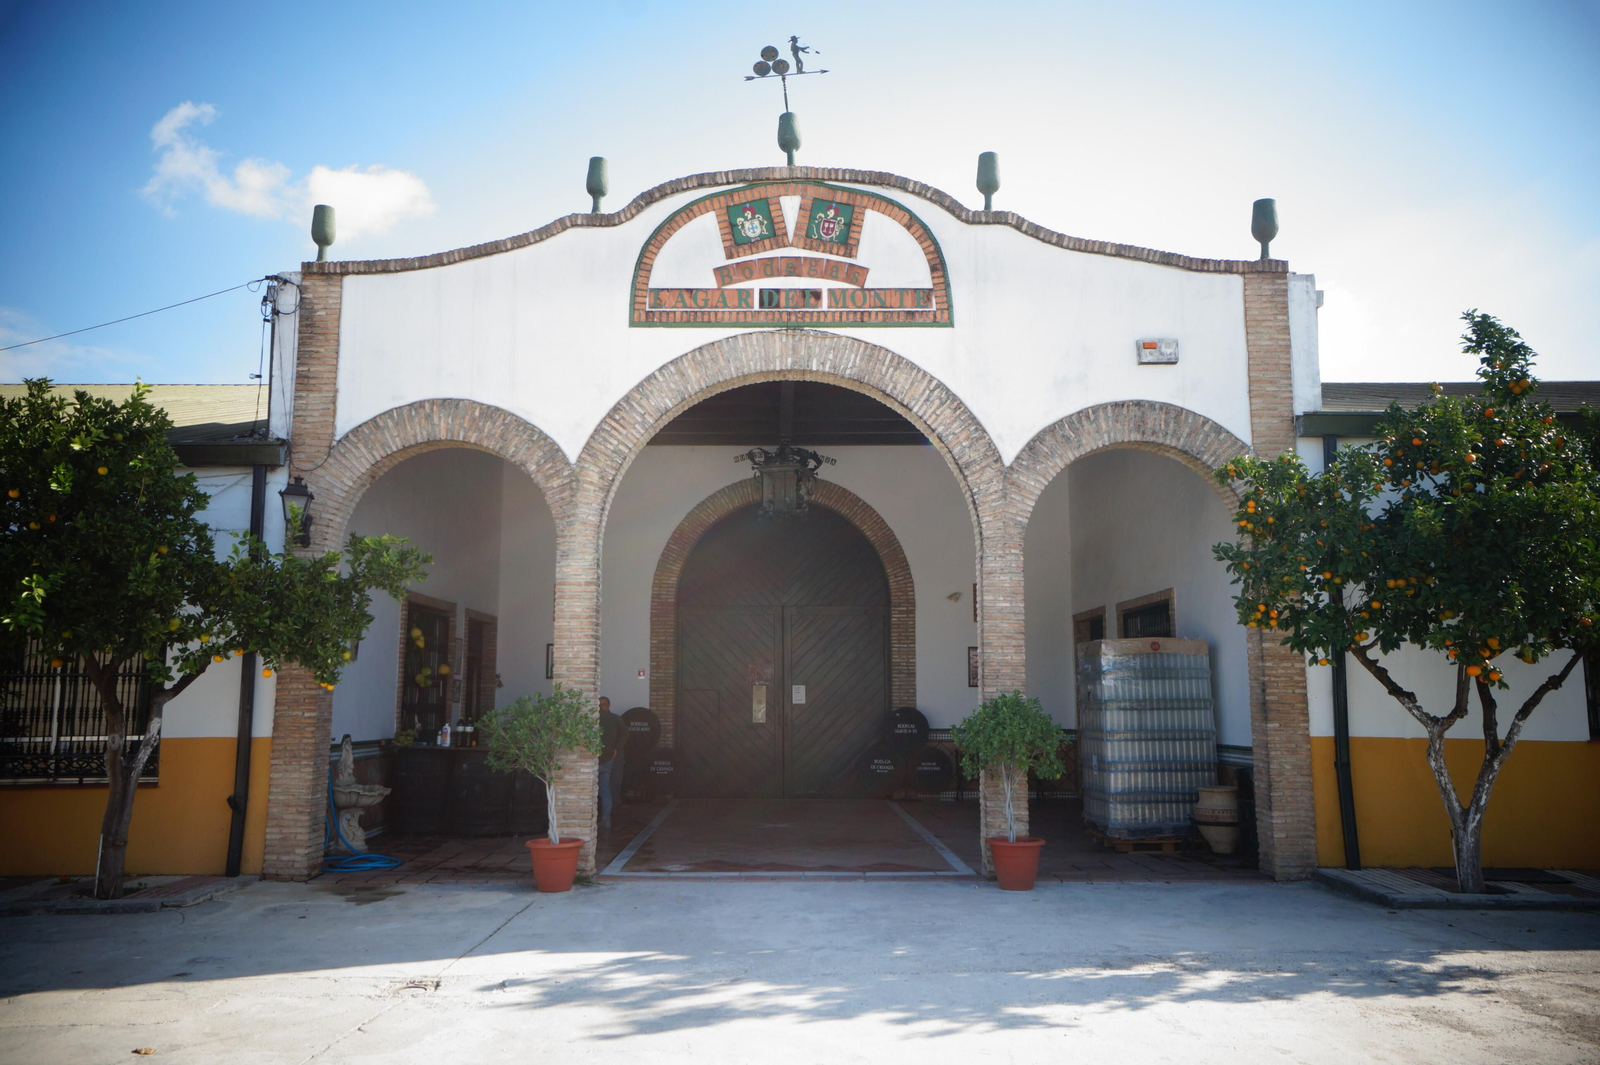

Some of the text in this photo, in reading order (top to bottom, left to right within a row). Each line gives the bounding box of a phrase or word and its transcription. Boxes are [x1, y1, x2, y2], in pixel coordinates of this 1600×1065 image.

[719, 258, 861, 287] Bodegas
[650, 289, 930, 308] LAGAR DEL MONTE
